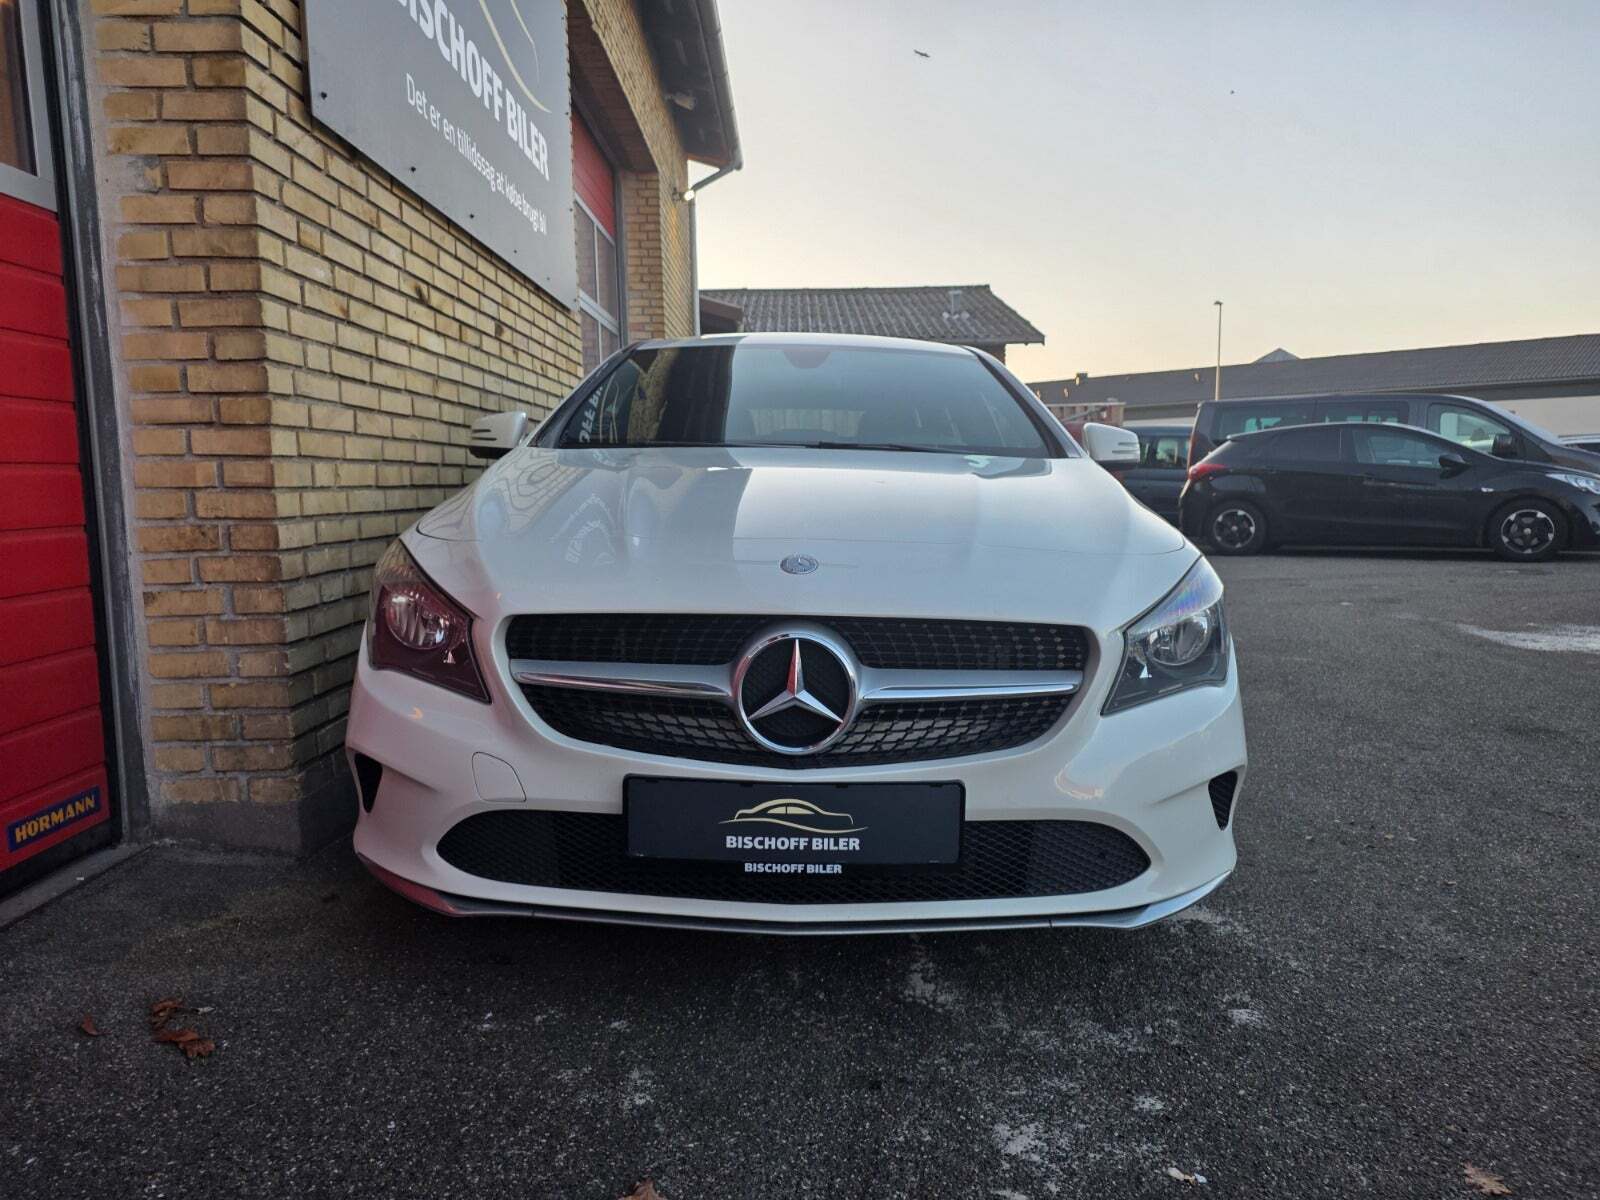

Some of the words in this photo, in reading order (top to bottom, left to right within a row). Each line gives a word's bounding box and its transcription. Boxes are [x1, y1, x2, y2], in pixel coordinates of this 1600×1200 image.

[398, 0, 503, 122] SCHOFF
[505, 87, 550, 181] BILER
[406, 72, 428, 120] Det
[430, 105, 440, 132] er
[443, 118, 456, 147] en
[457, 127, 496, 192] tillidssag
[496, 171, 505, 195] at
[725, 835, 809, 850] BISCHOFF
[811, 838, 861, 851] BILER
[744, 863, 804, 873] BISCHOFF
[806, 864, 842, 873] BILER
